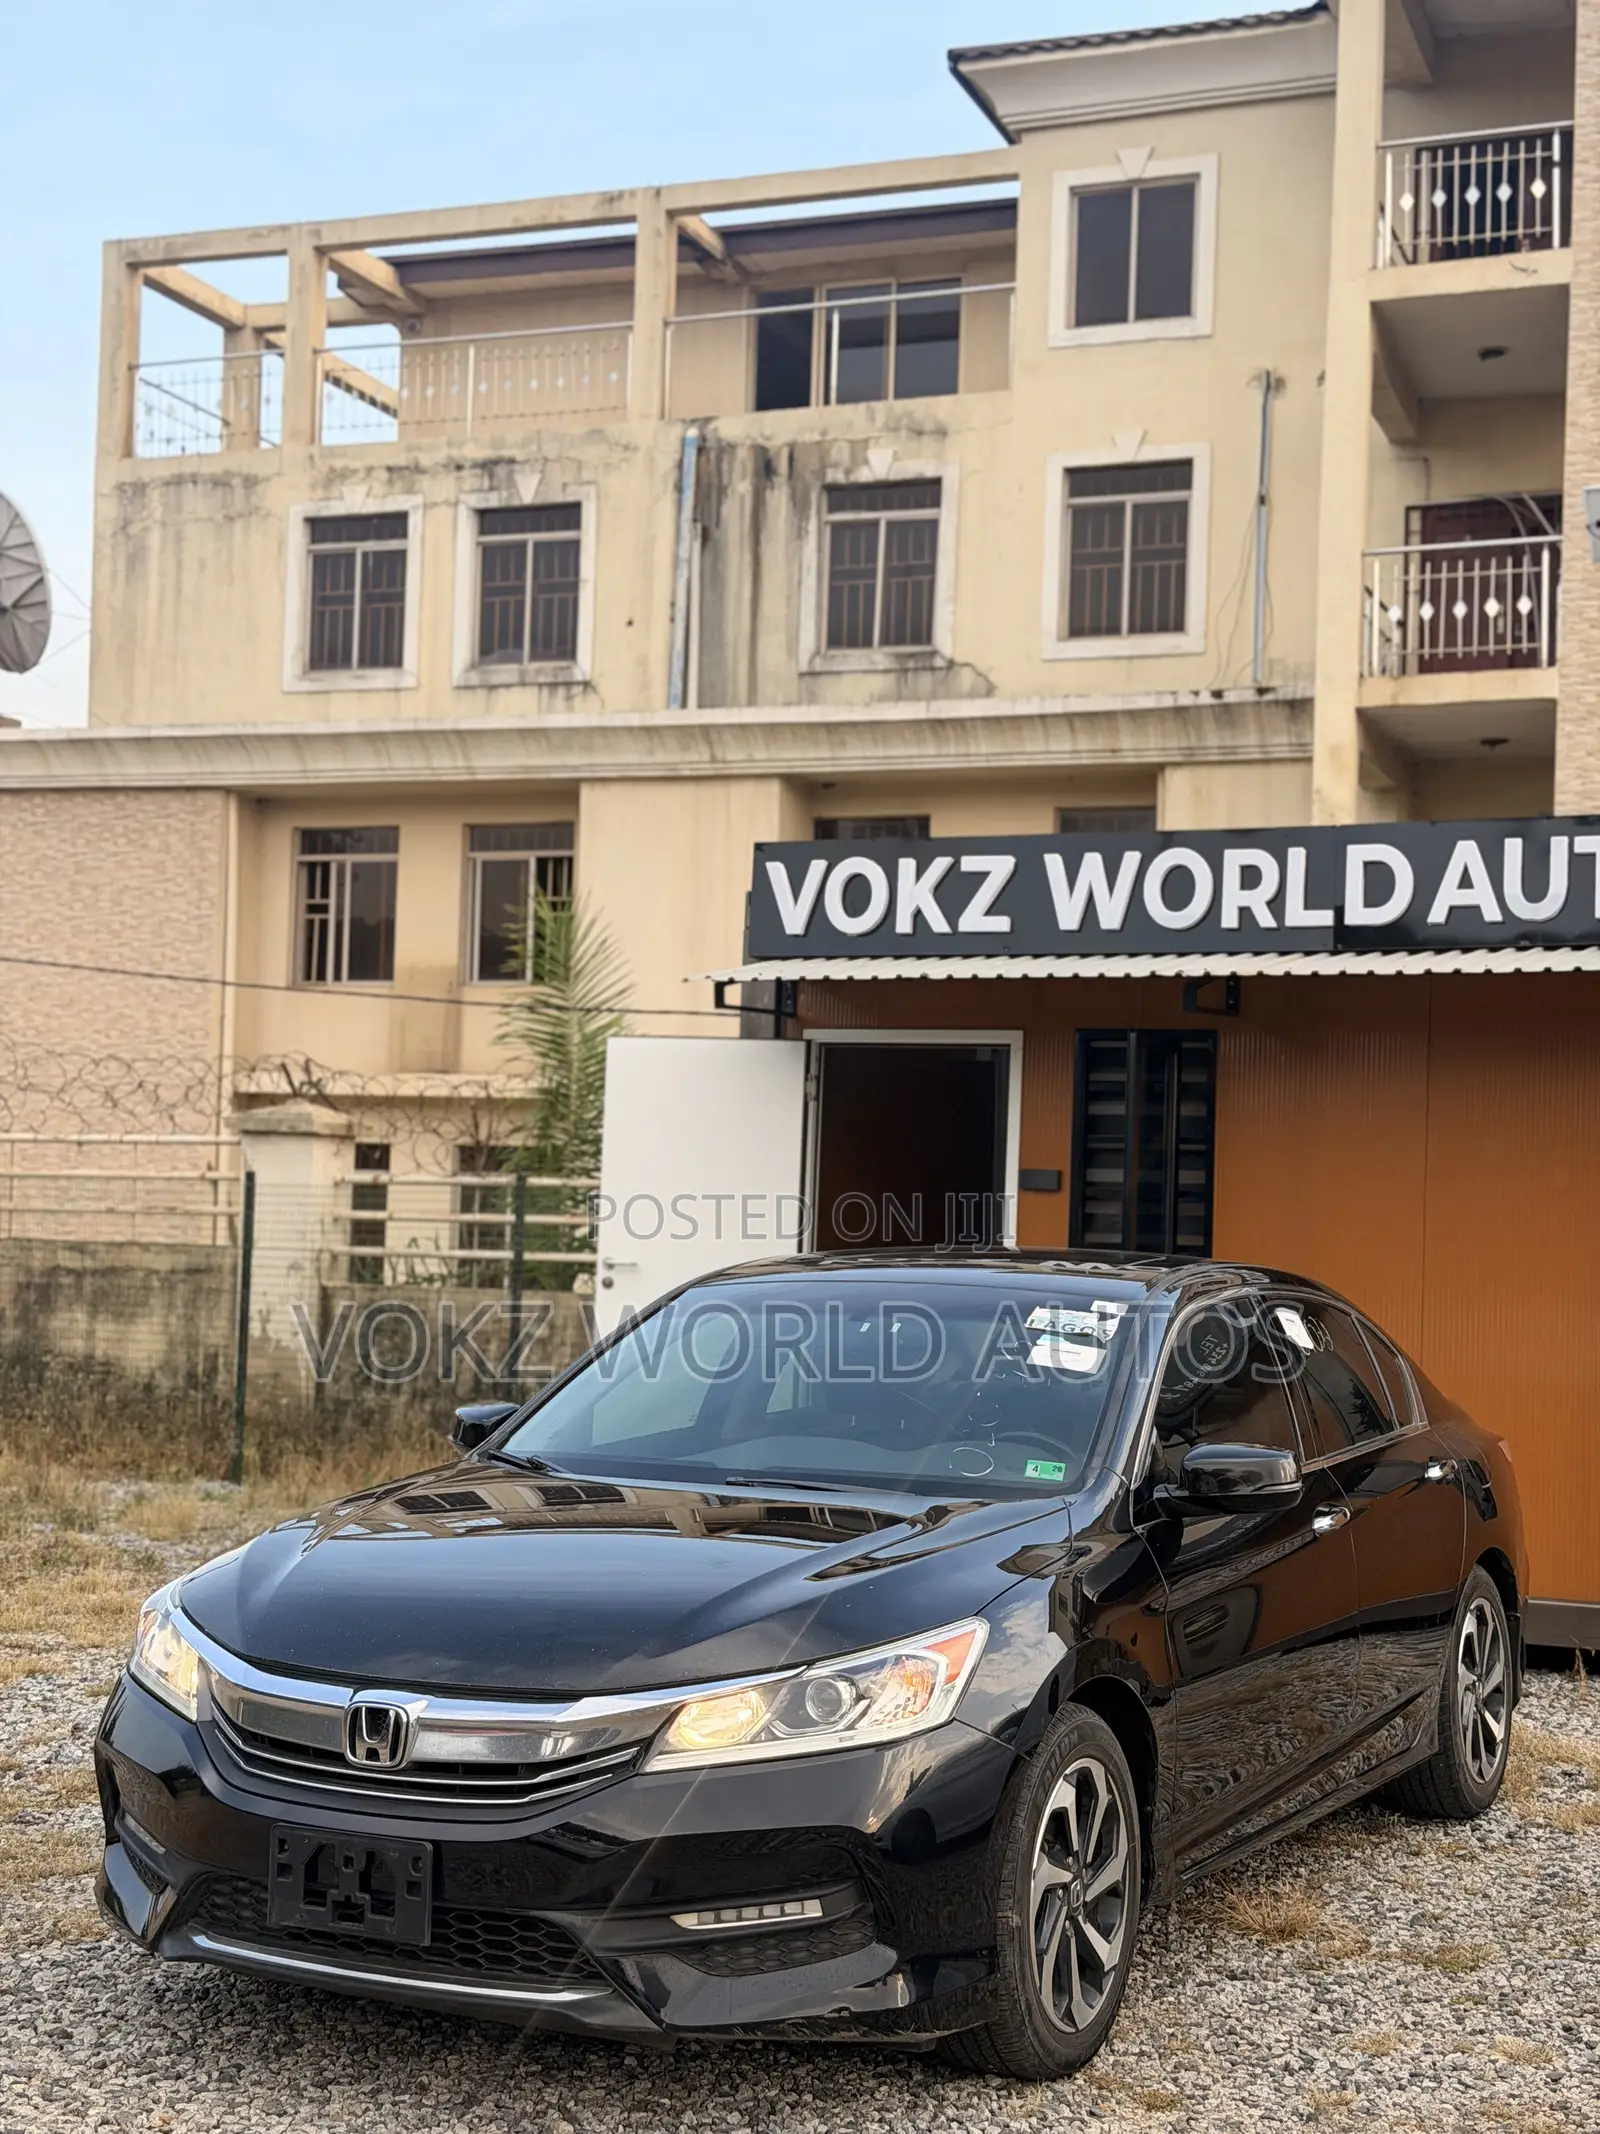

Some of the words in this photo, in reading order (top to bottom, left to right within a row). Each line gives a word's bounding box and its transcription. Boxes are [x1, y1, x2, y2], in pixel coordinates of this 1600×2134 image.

[765, 855, 1016, 936] VOKZ
[1043, 844, 1414, 931] WORLD
[1032, 1464, 1039, 1473] 4
